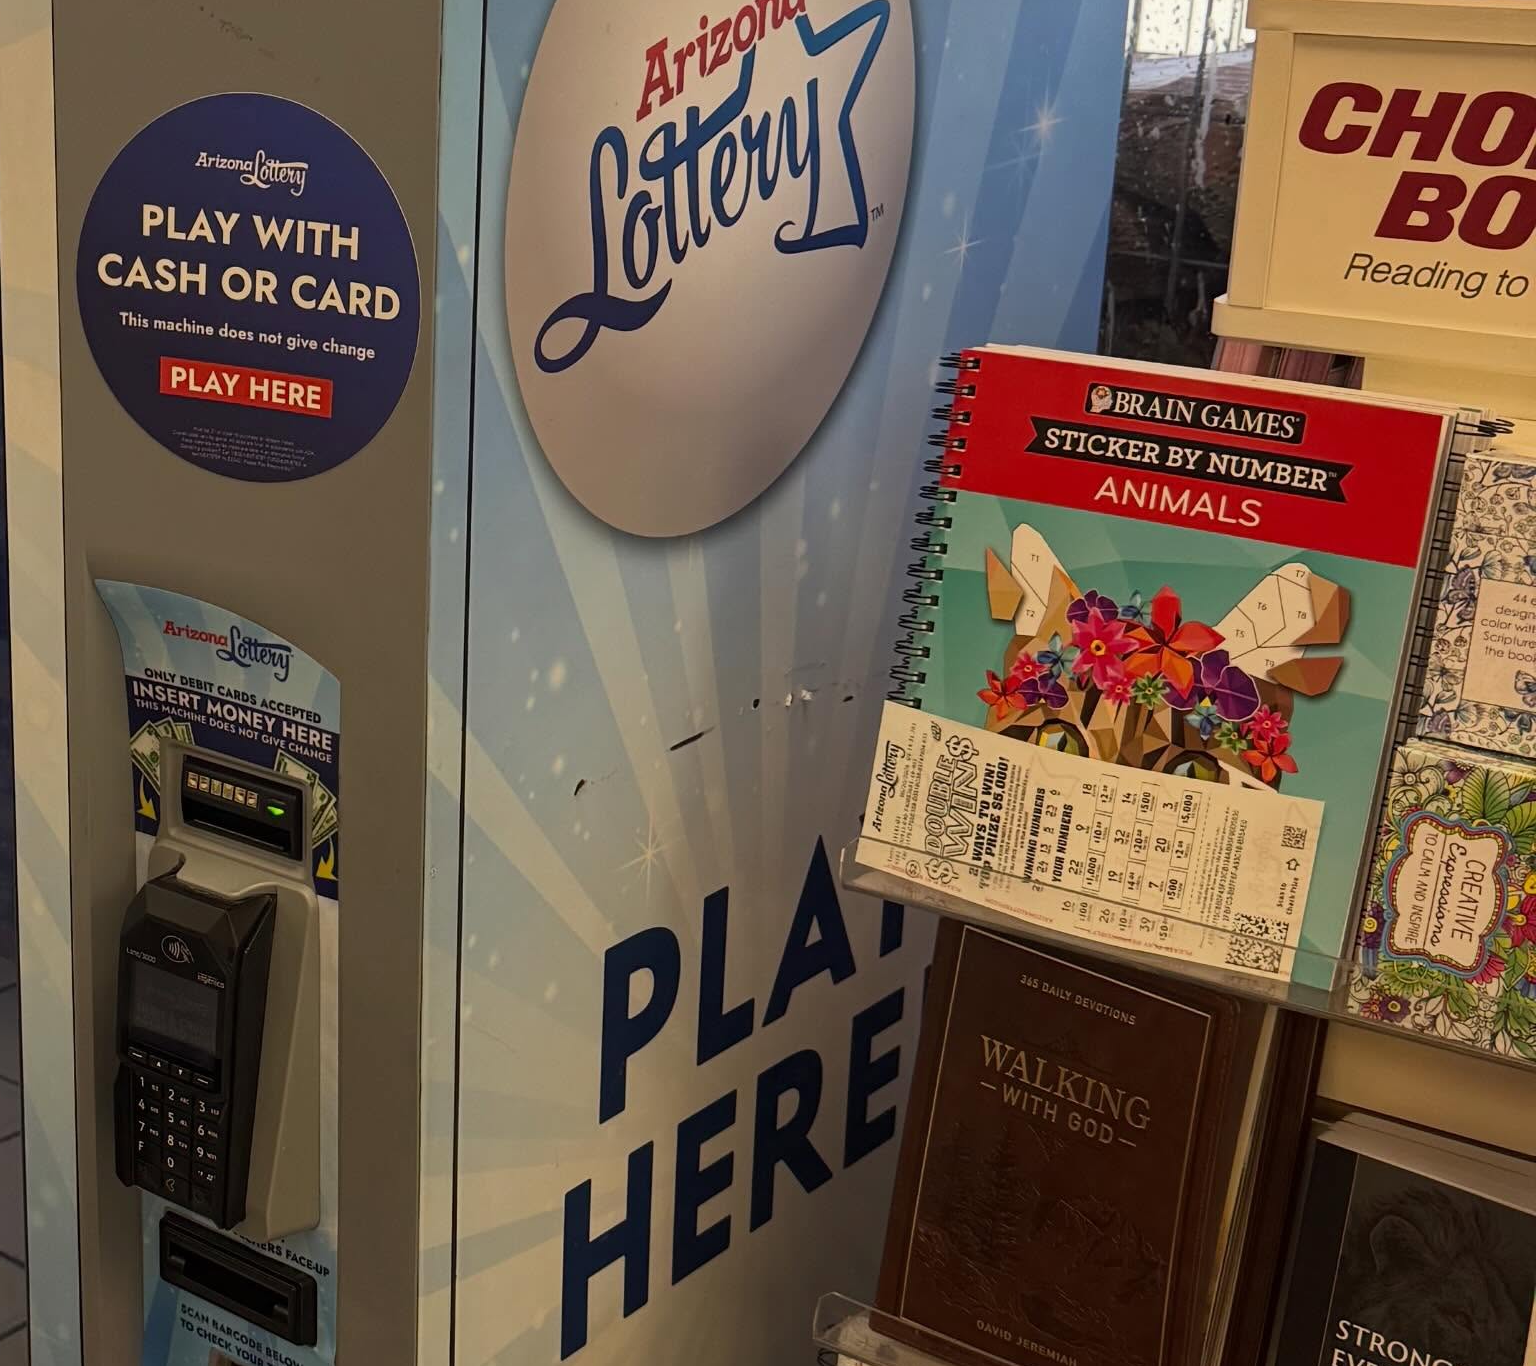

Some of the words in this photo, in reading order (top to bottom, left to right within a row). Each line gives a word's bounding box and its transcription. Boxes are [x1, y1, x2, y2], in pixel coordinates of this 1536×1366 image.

[1299, 81, 1536, 170] CHO
[195, 152, 252, 172] Arizona
[240, 150, 308, 196] Lottery
[534, 35, 854, 373] Lottery
[142, 204, 240, 245] PLAY
[252, 215, 359, 260] WITH
[97, 254, 207, 295] CASH
[221, 267, 278, 305] OR
[291, 278, 400, 321] CARD
[1344, 252, 1488, 299] Reading
[1495, 270, 1530, 297] to
[119, 312, 149, 328] This
[153, 317, 214, 336] machine
[218, 323, 254, 341] does
[258, 330, 282, 345] not
[286, 334, 318, 353] give
[323, 337, 375, 361] change
[171, 365, 240, 397] PLAY
[249, 377, 321, 410] HERE
[1112, 390, 1199, 428] BRAIN
[1043, 426, 1161, 467] STICKER
[1166, 445, 1202, 472] BY
[1095, 475, 1263, 527] ANIMALS
[163, 620, 227, 648] Arizona
[216, 625, 292, 683] Lottery
[132, 679, 201, 712] INSERT
[206, 699, 276, 734] MONEY
[282, 721, 332, 751] HERE
[144, 667, 176, 684] ONLY
[180, 673, 214, 693] DEBIT
[217, 685, 256, 706] CARDS
[260, 696, 321, 724] ACCEPTED
[135, 698, 159, 712] THIS
[161, 704, 207, 726] MACHINE
[209, 716, 236, 734] DOES
[238, 726, 259, 740] NOT
[262, 733, 286, 748] GIVE
[288, 742, 332, 764] CHANGE
[875, 740, 905, 799] Lottery
[981, 761, 996, 803] WIN!
[871, 783, 888, 832] Arizona
[924, 754, 957, 856] DOUBLE
[979, 803, 990, 819] TO
[972, 823, 988, 863] WAYS
[984, 814, 1001, 861] PRIZE
[1431, 842, 1467, 946] Expressions
[1452, 859, 1487, 942] CREATIVE
[1020, 974, 1039, 990] 365
[1042, 981, 1072, 1002] DAILY
[1074, 992, 1136, 1026] DEVOTIONS
[980, 1035, 1152, 1130] WALKING
[1002, 1084, 1057, 1123] WITH
[1068, 1111, 1114, 1145] GOD
[561, 986, 905, 1361] HERE
[285, 1249, 330, 1278] FACE-UP
[180, 1304, 210, 1327] SCAN
[212, 1315, 263, 1353] BARCODE
[180, 1318, 195, 1333] TO
[196, 1326, 232, 1353] CHECK
